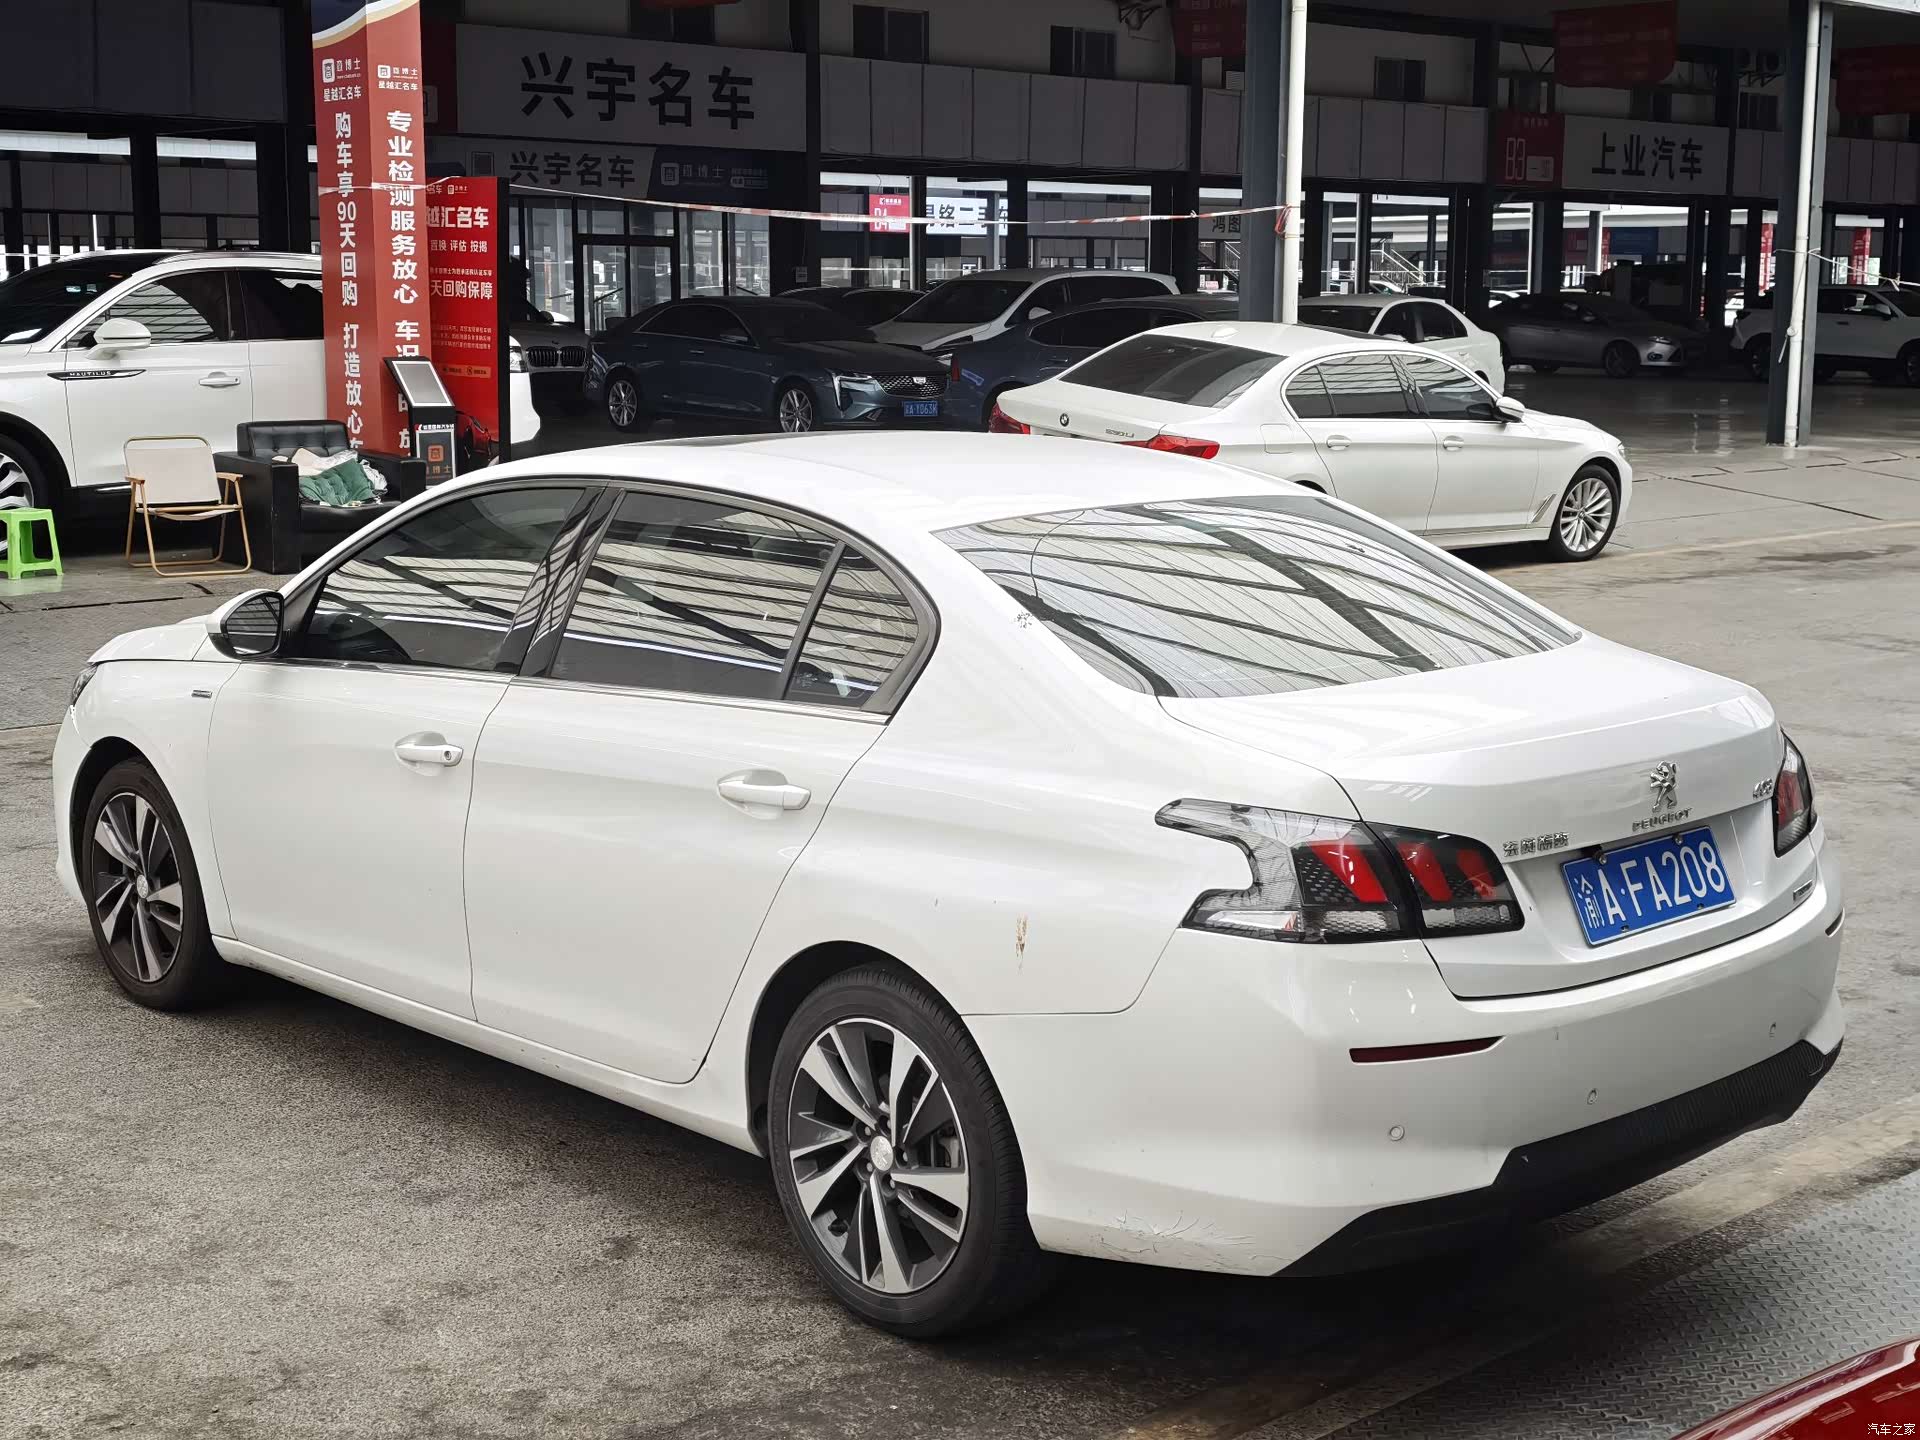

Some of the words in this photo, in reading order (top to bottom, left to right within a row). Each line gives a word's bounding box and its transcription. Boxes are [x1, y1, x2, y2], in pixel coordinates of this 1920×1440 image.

[323, 85, 362, 102] 星越汇名车
[378, 80, 418, 91] 星越汇名车
[520, 52, 755, 130] 兴宇名车
[509, 151, 635, 188] 兴宇名车
[1591, 132, 1703, 181] 上业汽车
[335, 112, 358, 307] 购车享90天回购
[386, 110, 419, 304] 专业检测服务放心
[450, 239, 467, 252] 评估
[470, 240, 488, 253] 按揭
[430, 279, 493, 300] 天回购保障
[1632, 807, 1693, 832] PEUGEOT
[1573, 841, 1726, 929] 渝A·FA208
